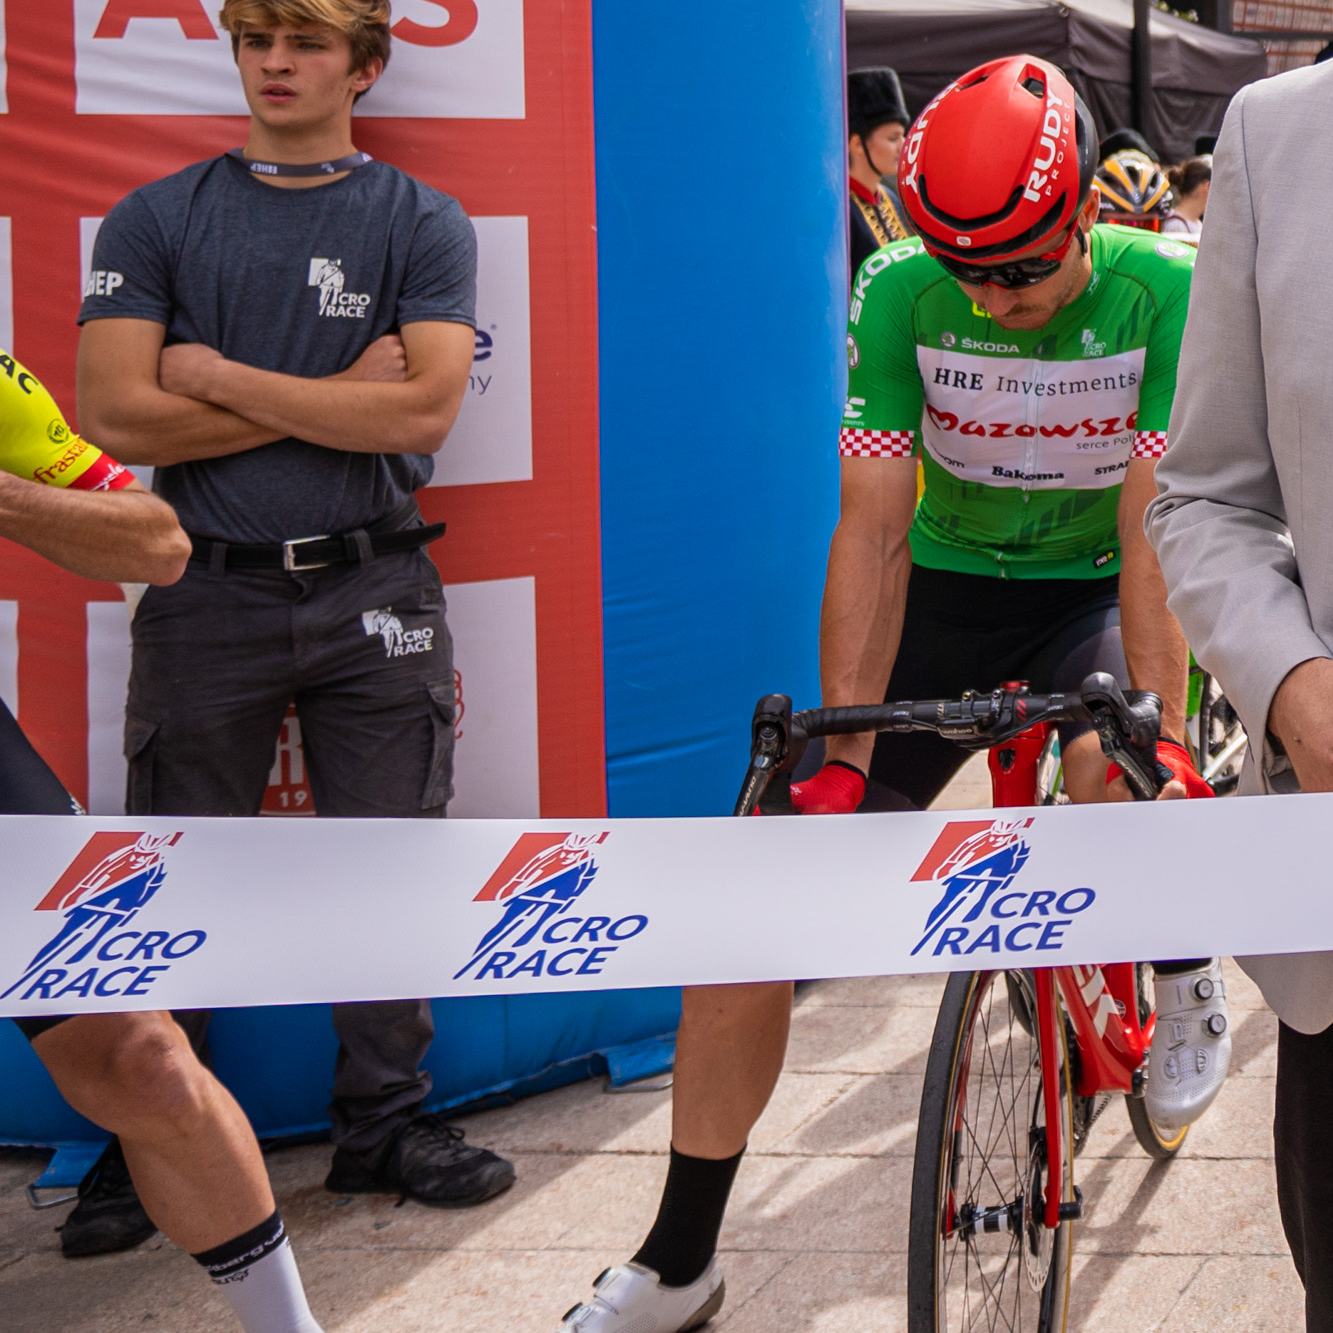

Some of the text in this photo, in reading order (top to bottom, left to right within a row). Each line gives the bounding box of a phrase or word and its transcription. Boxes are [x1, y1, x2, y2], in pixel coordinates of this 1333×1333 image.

[1023, 92, 1063, 203] RUDY
[1045, 102, 1071, 197] PROJECT
[326, 305, 365, 317] RACE
[338, 293, 370, 306] CRO
[961, 337, 1020, 353] ŠKODA
[933, 367, 1137, 397] HRE Investments
[991, 465, 1065, 481] Bakoma
[394, 639, 433, 657] RACE
[403, 627, 434, 643] CRO
[991, 887, 1096, 919] CRO
[100, 930, 207, 962] CRO
[542, 915, 649, 947] CRO
[933, 919, 1072, 956] RACE
[474, 945, 619, 981] RACE
[20, 965, 172, 1000] RACE
